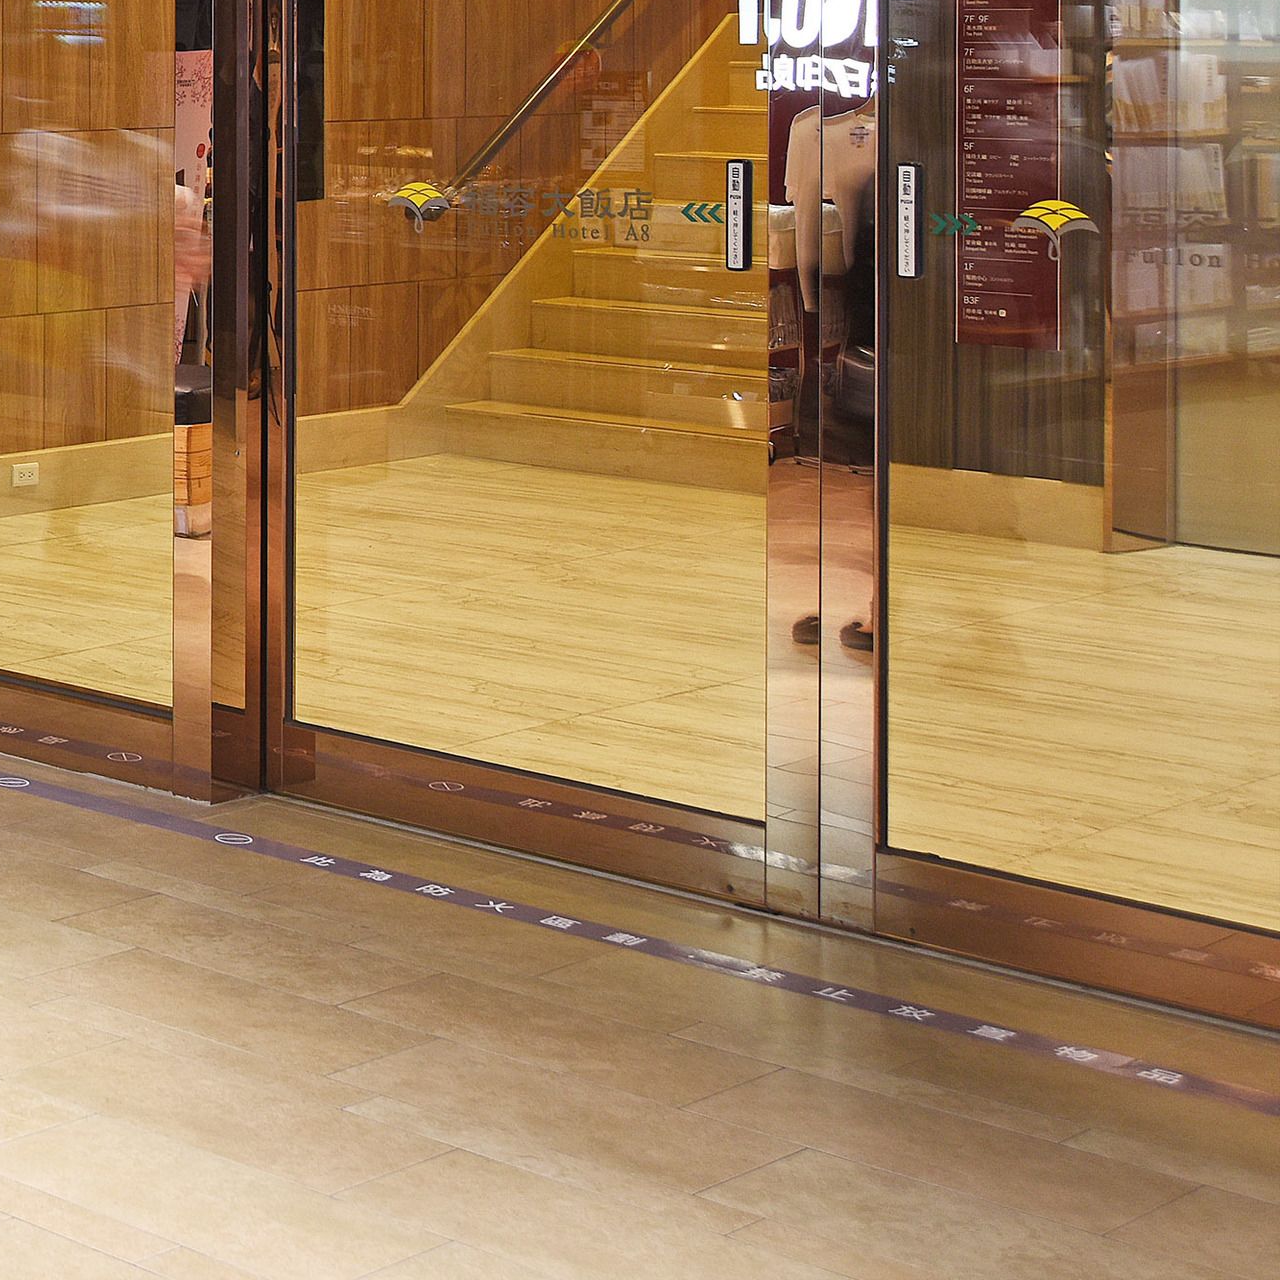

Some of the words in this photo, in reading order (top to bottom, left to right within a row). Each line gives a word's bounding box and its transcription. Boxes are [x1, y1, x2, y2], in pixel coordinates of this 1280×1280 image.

[964, 14, 975, 23] 7F
[978, 14, 989, 23] 9F
[964, 48, 975, 56] 7F
[963, 84, 975, 93] 6F
[963, 142, 975, 150] 5F
[464, 187, 654, 220] 福容大飯店
[552, 223, 610, 240] Hotel
[624, 223, 650, 242] A8
[964, 263, 975, 271] 1F
[963, 296, 980, 304] B3F
